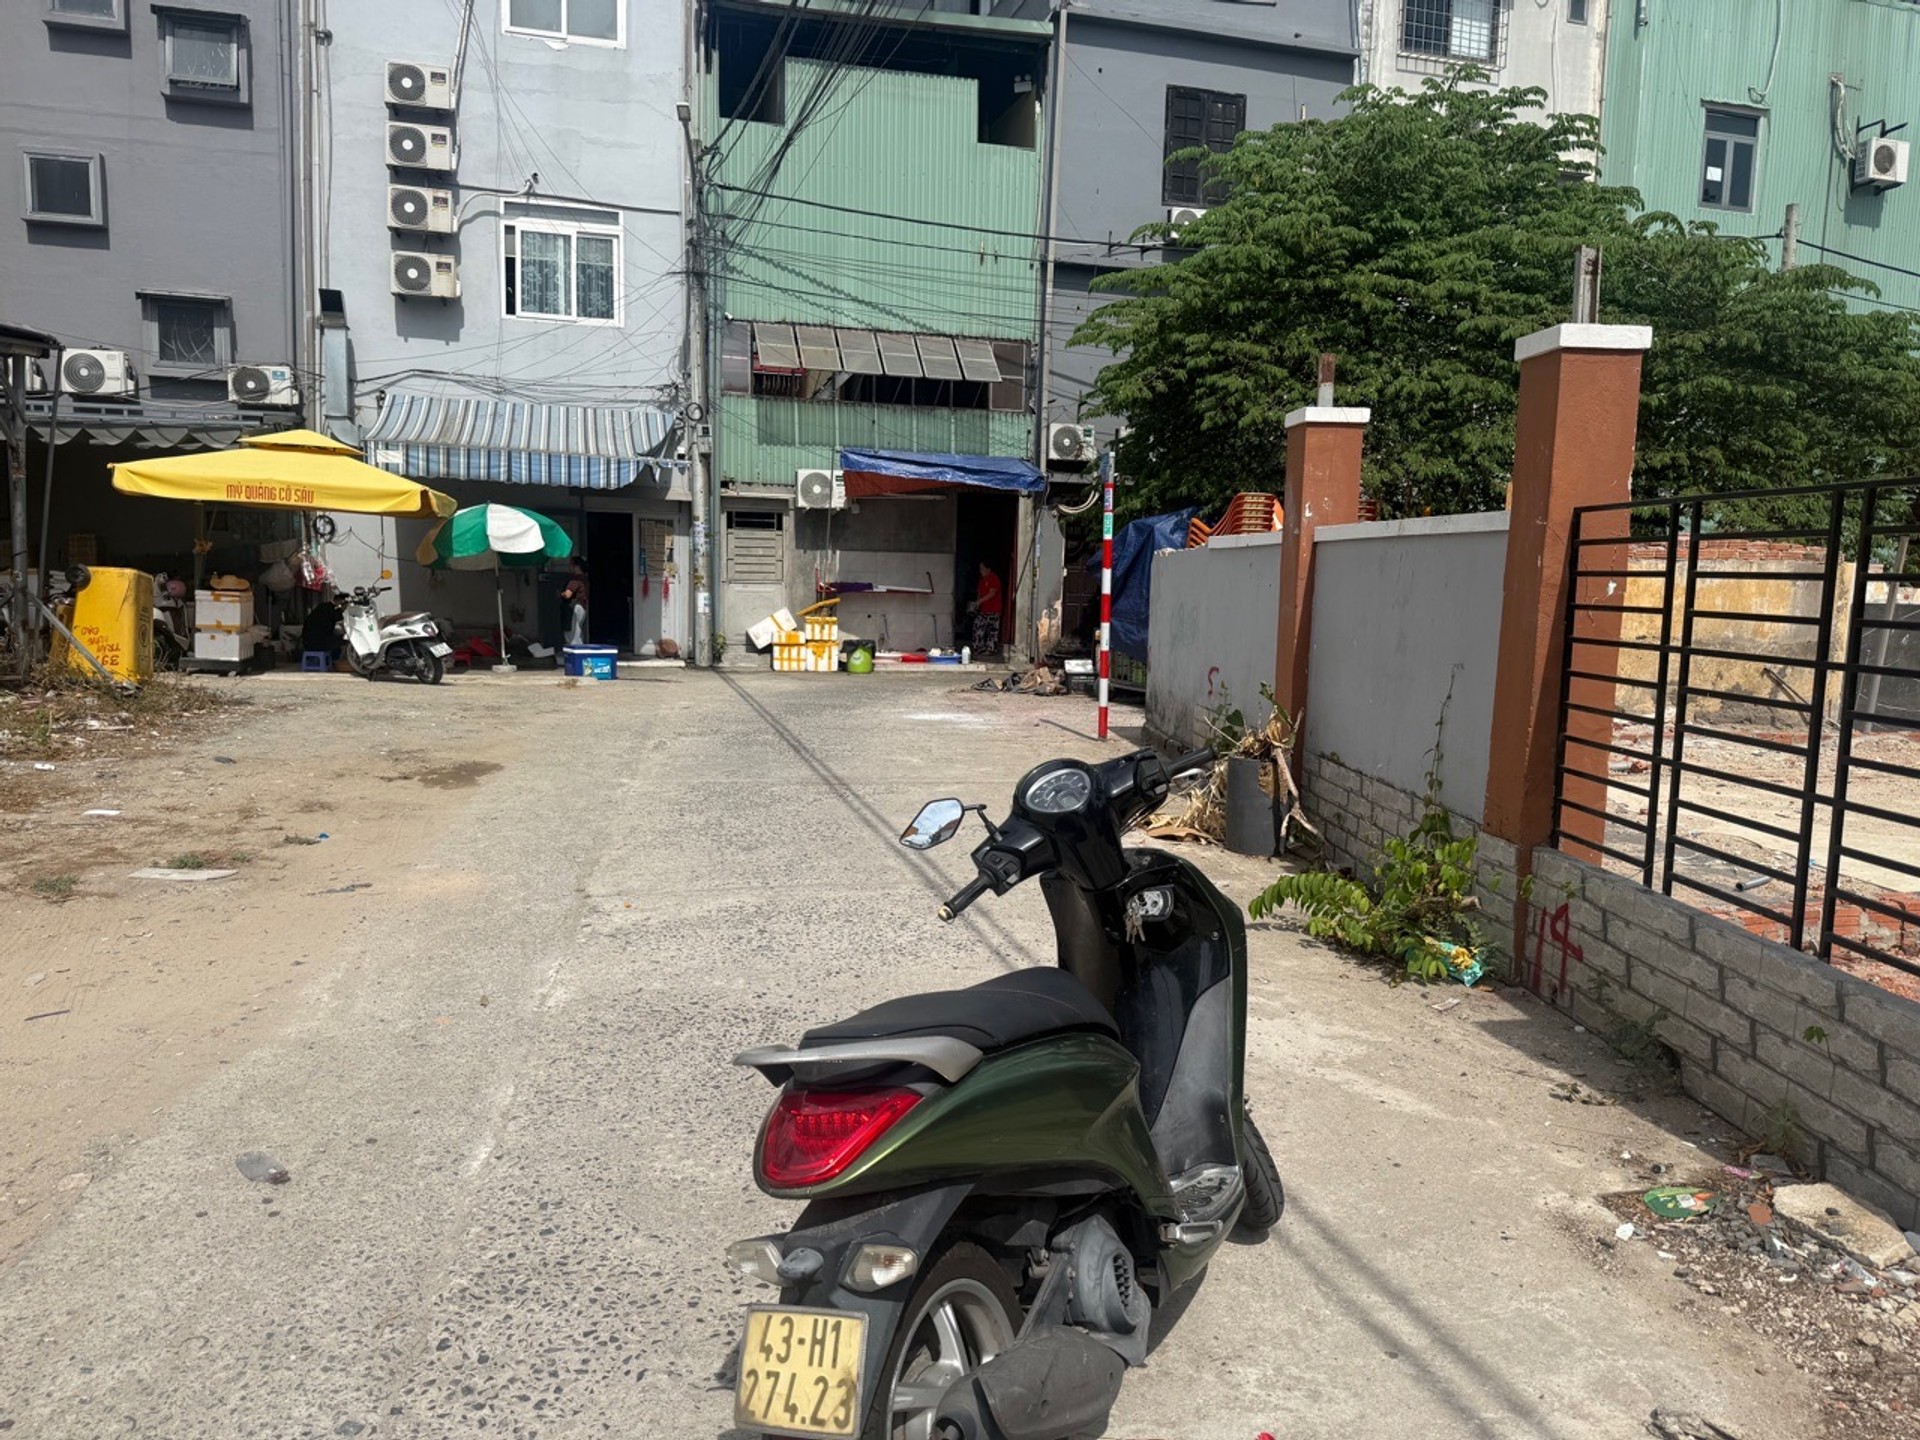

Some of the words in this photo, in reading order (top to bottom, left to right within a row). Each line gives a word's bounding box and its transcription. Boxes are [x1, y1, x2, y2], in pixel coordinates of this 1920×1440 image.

[244, 482, 277, 501] QUẢNG
[278, 485, 292, 502] CÔ
[294, 486, 315, 504] SÁU
[758, 1313, 843, 1370] 43-H1
[743, 1367, 857, 1430] 274.23
